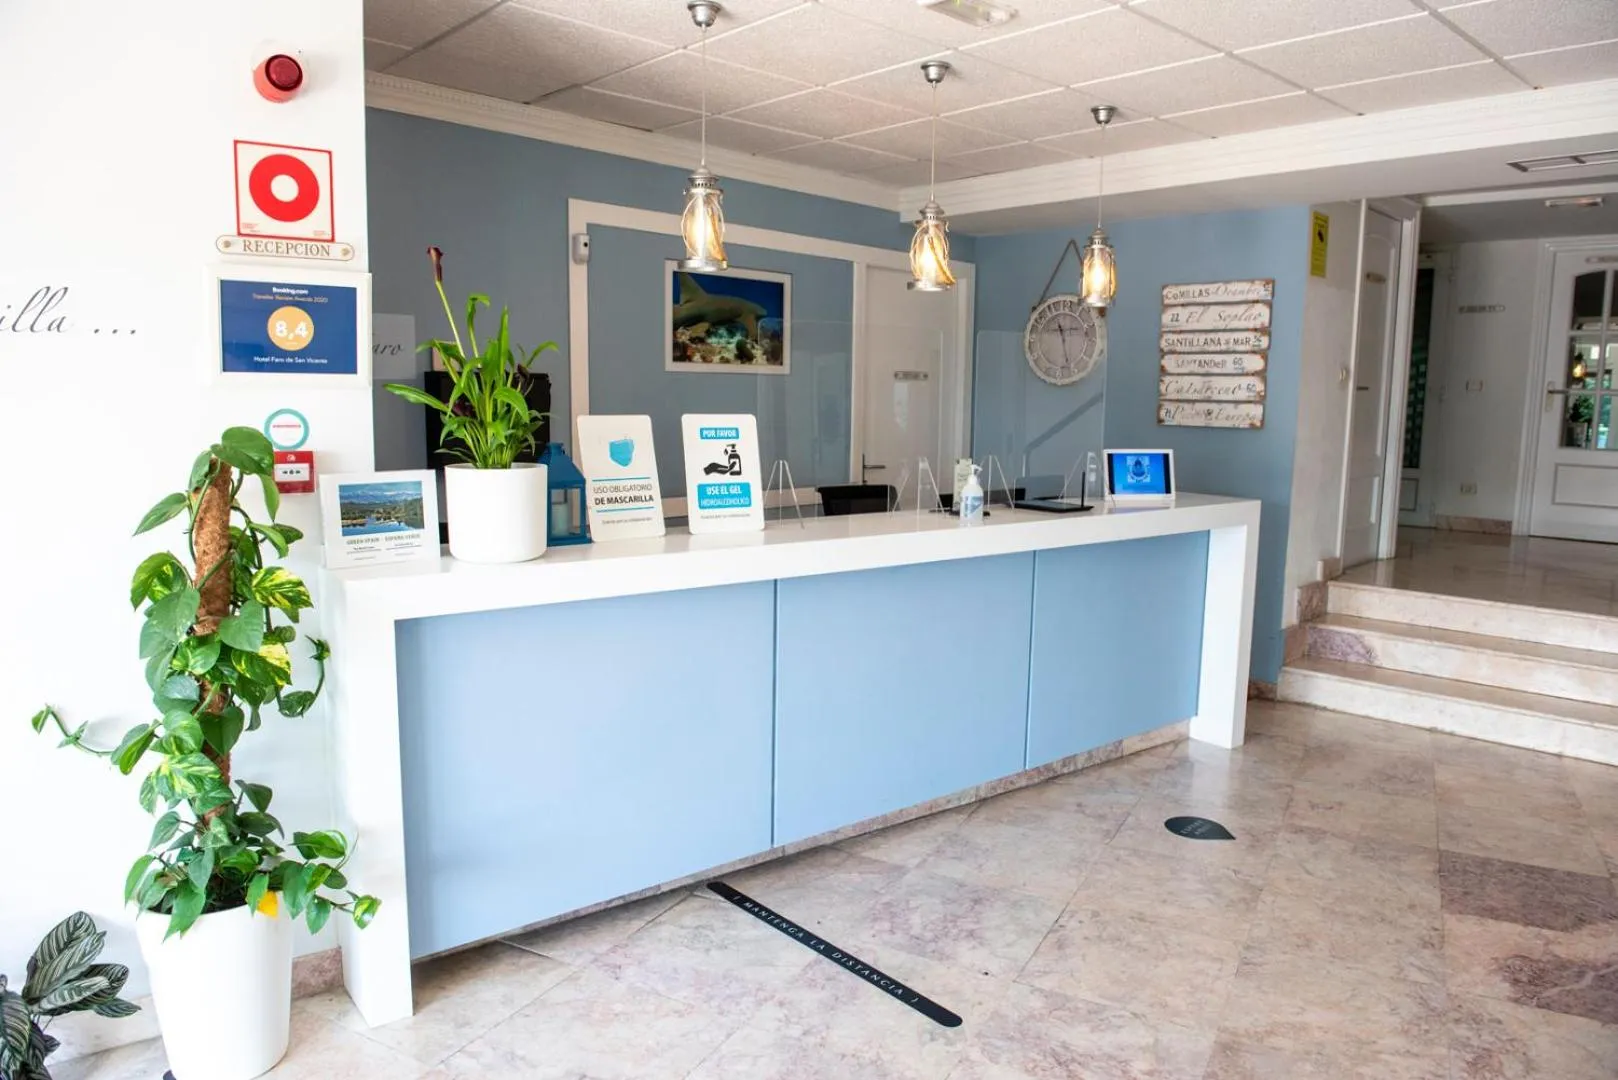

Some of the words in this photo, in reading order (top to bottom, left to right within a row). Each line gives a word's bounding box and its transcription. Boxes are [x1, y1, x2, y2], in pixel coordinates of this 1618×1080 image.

[242, 239, 330, 257] RECEPCION
[275, 320, 308, 341] 8,4
[593, 485, 608, 493] USO
[609, 483, 653, 493] OBLIGATORIO
[706, 486, 720, 495] USE
[720, 486, 729, 495] EL
[730, 485, 742, 494] GEL
[594, 497, 606, 505] DE
[606, 494, 654, 505] MASCARILLA
[743, 901, 804, 939] MANTENGA
[810, 940, 825, 950] LA
[831, 952, 904, 996] DISTANCIA
